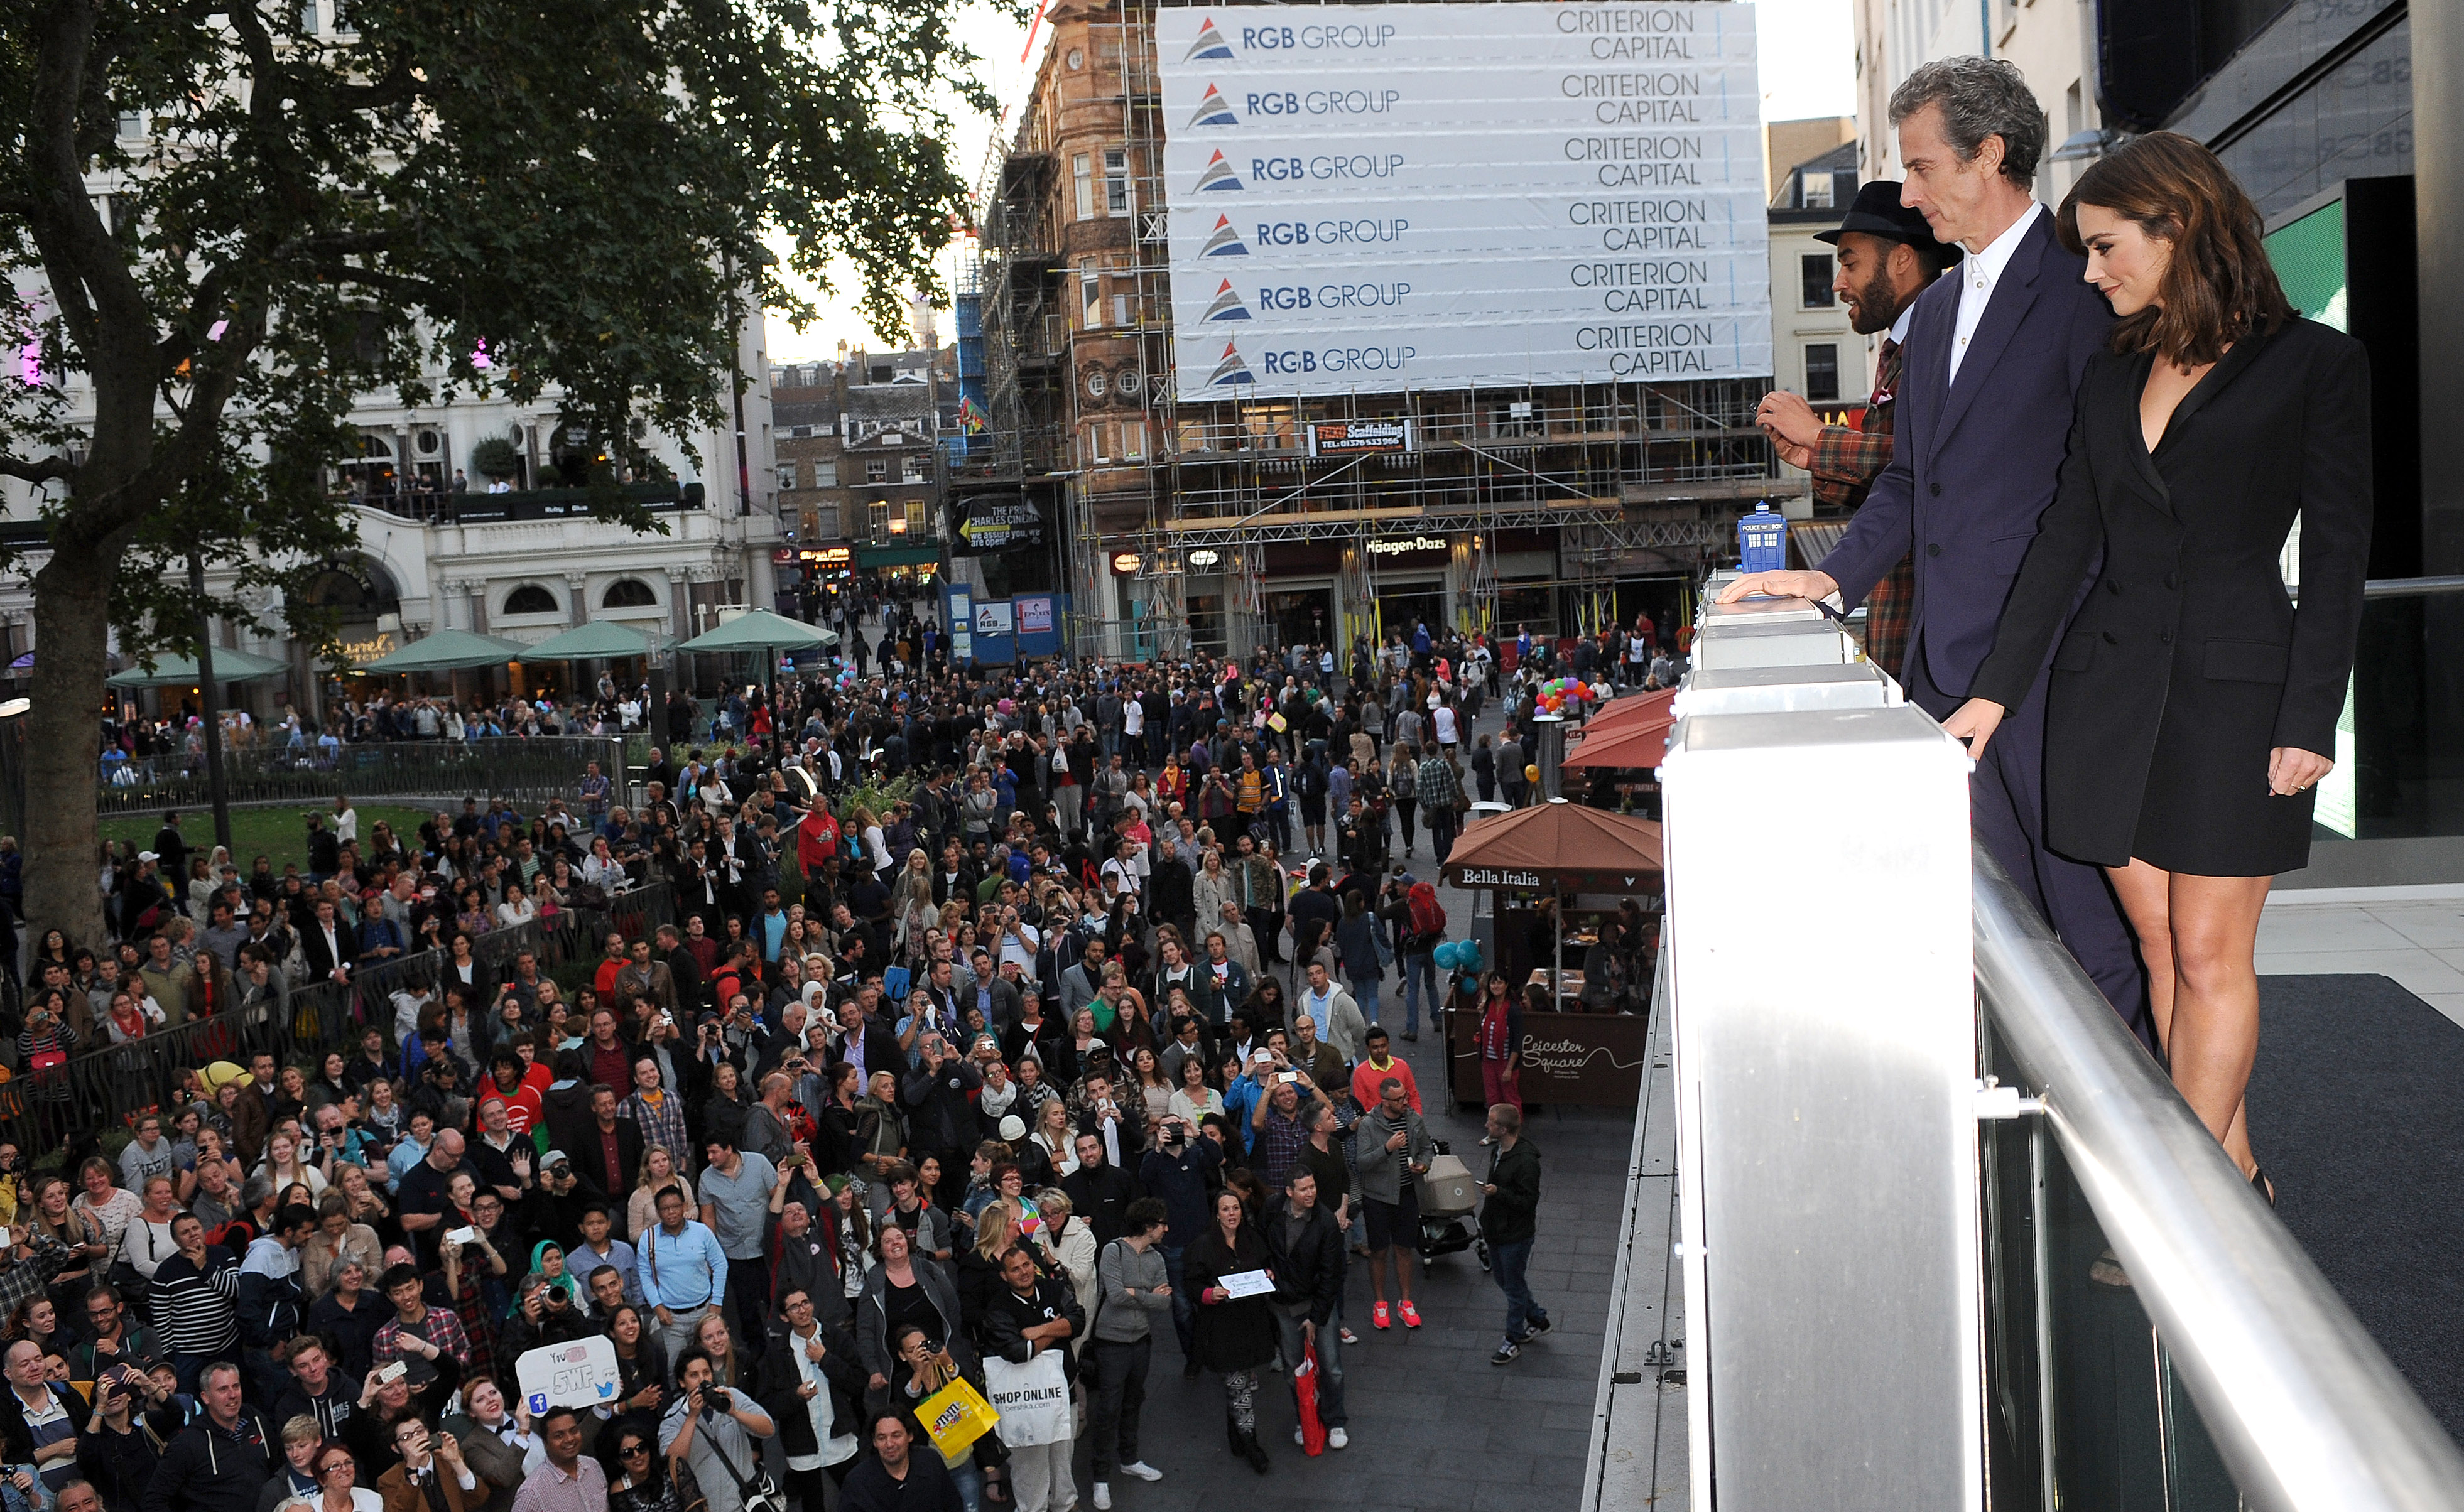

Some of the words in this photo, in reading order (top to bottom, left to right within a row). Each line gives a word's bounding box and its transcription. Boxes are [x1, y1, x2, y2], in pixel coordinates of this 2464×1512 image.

[1556, 9, 1694, 35] CRITERION
[1243, 27, 1294, 50] RGB
[1301, 24, 1396, 48] GROUP
[1591, 36, 1693, 60] CAPITAL
[1561, 73, 1699, 97] CRITERION
[1247, 92, 1299, 115] RGB
[1305, 90, 1400, 114] GROUP
[1596, 100, 1698, 124] CAPITAL
[1565, 136, 1701, 160] CRITERION
[1252, 158, 1304, 180] RGB
[1310, 155, 1404, 179] GROUP
[1598, 164, 1701, 186] CAPITAL
[1569, 200, 1705, 225] CRITERION
[1257, 222, 1310, 246] RGB
[1315, 219, 1409, 244] GROUP
[1603, 226, 1707, 250] CAPITAL
[1571, 261, 1707, 286] CRITERION
[1259, 287, 1313, 311] RGB
[1318, 283, 1411, 308] GROUP
[1604, 288, 1708, 312] CAPITAL
[1576, 323, 1713, 349] CRITERION
[1264, 350, 1316, 374] RGB
[1322, 347, 1416, 371] GROUP
[1609, 350, 1713, 375] CAPITAL
[1347, 423, 1403, 439] Scaffolding
[992, 506, 1008, 516] THE
[984, 531, 1011, 539] assure
[980, 620, 998, 628] RGB
[1463, 869, 1499, 884] Bella
[1502, 870, 1540, 887] Italia
[1522, 1035, 1585, 1053] Leicester
[1522, 1050, 1586, 1072] Square
[993, 1391, 1021, 1405] SHOP
[1023, 1386, 1062, 1401] ONLINE
